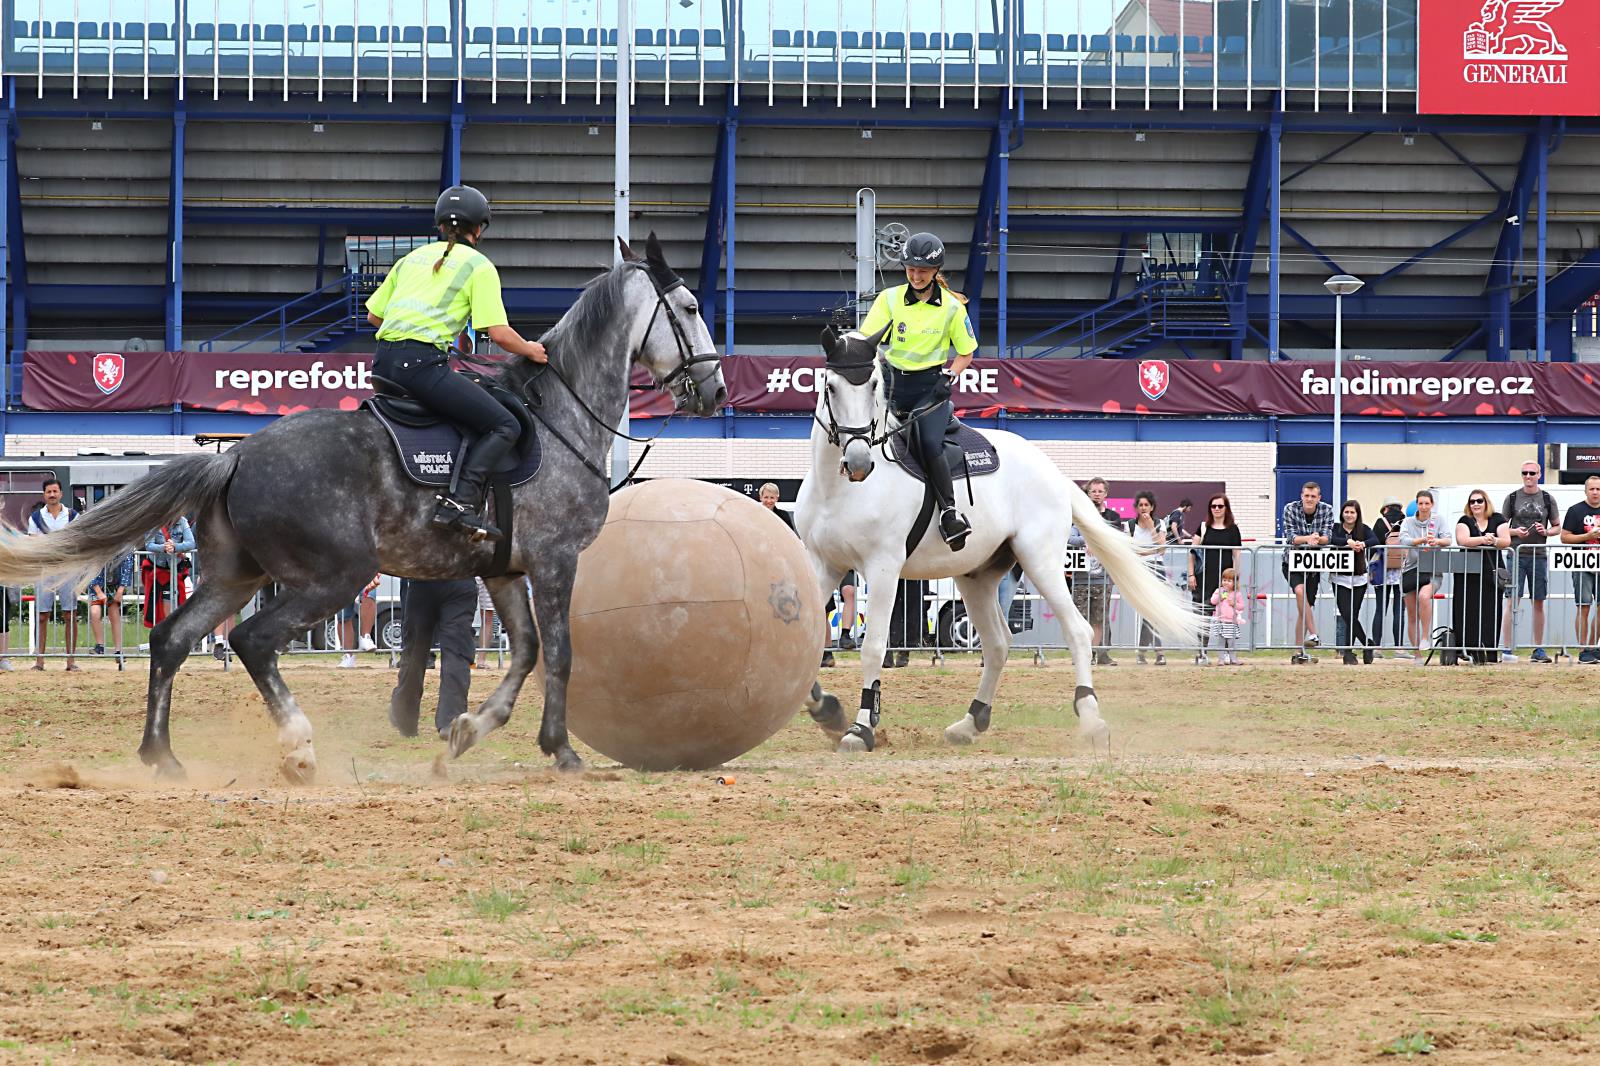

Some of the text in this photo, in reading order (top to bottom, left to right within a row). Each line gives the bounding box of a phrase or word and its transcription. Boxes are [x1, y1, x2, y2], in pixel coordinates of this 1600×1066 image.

[1463, 64, 1568, 84] GENERALI
[215, 361, 374, 396] reprefotb
[1300, 369, 1535, 401] fandimrepre.cz
[1064, 552, 1086, 569] CIE
[1293, 552, 1349, 569] POLICIE
[1554, 552, 1600, 569] POLICI
